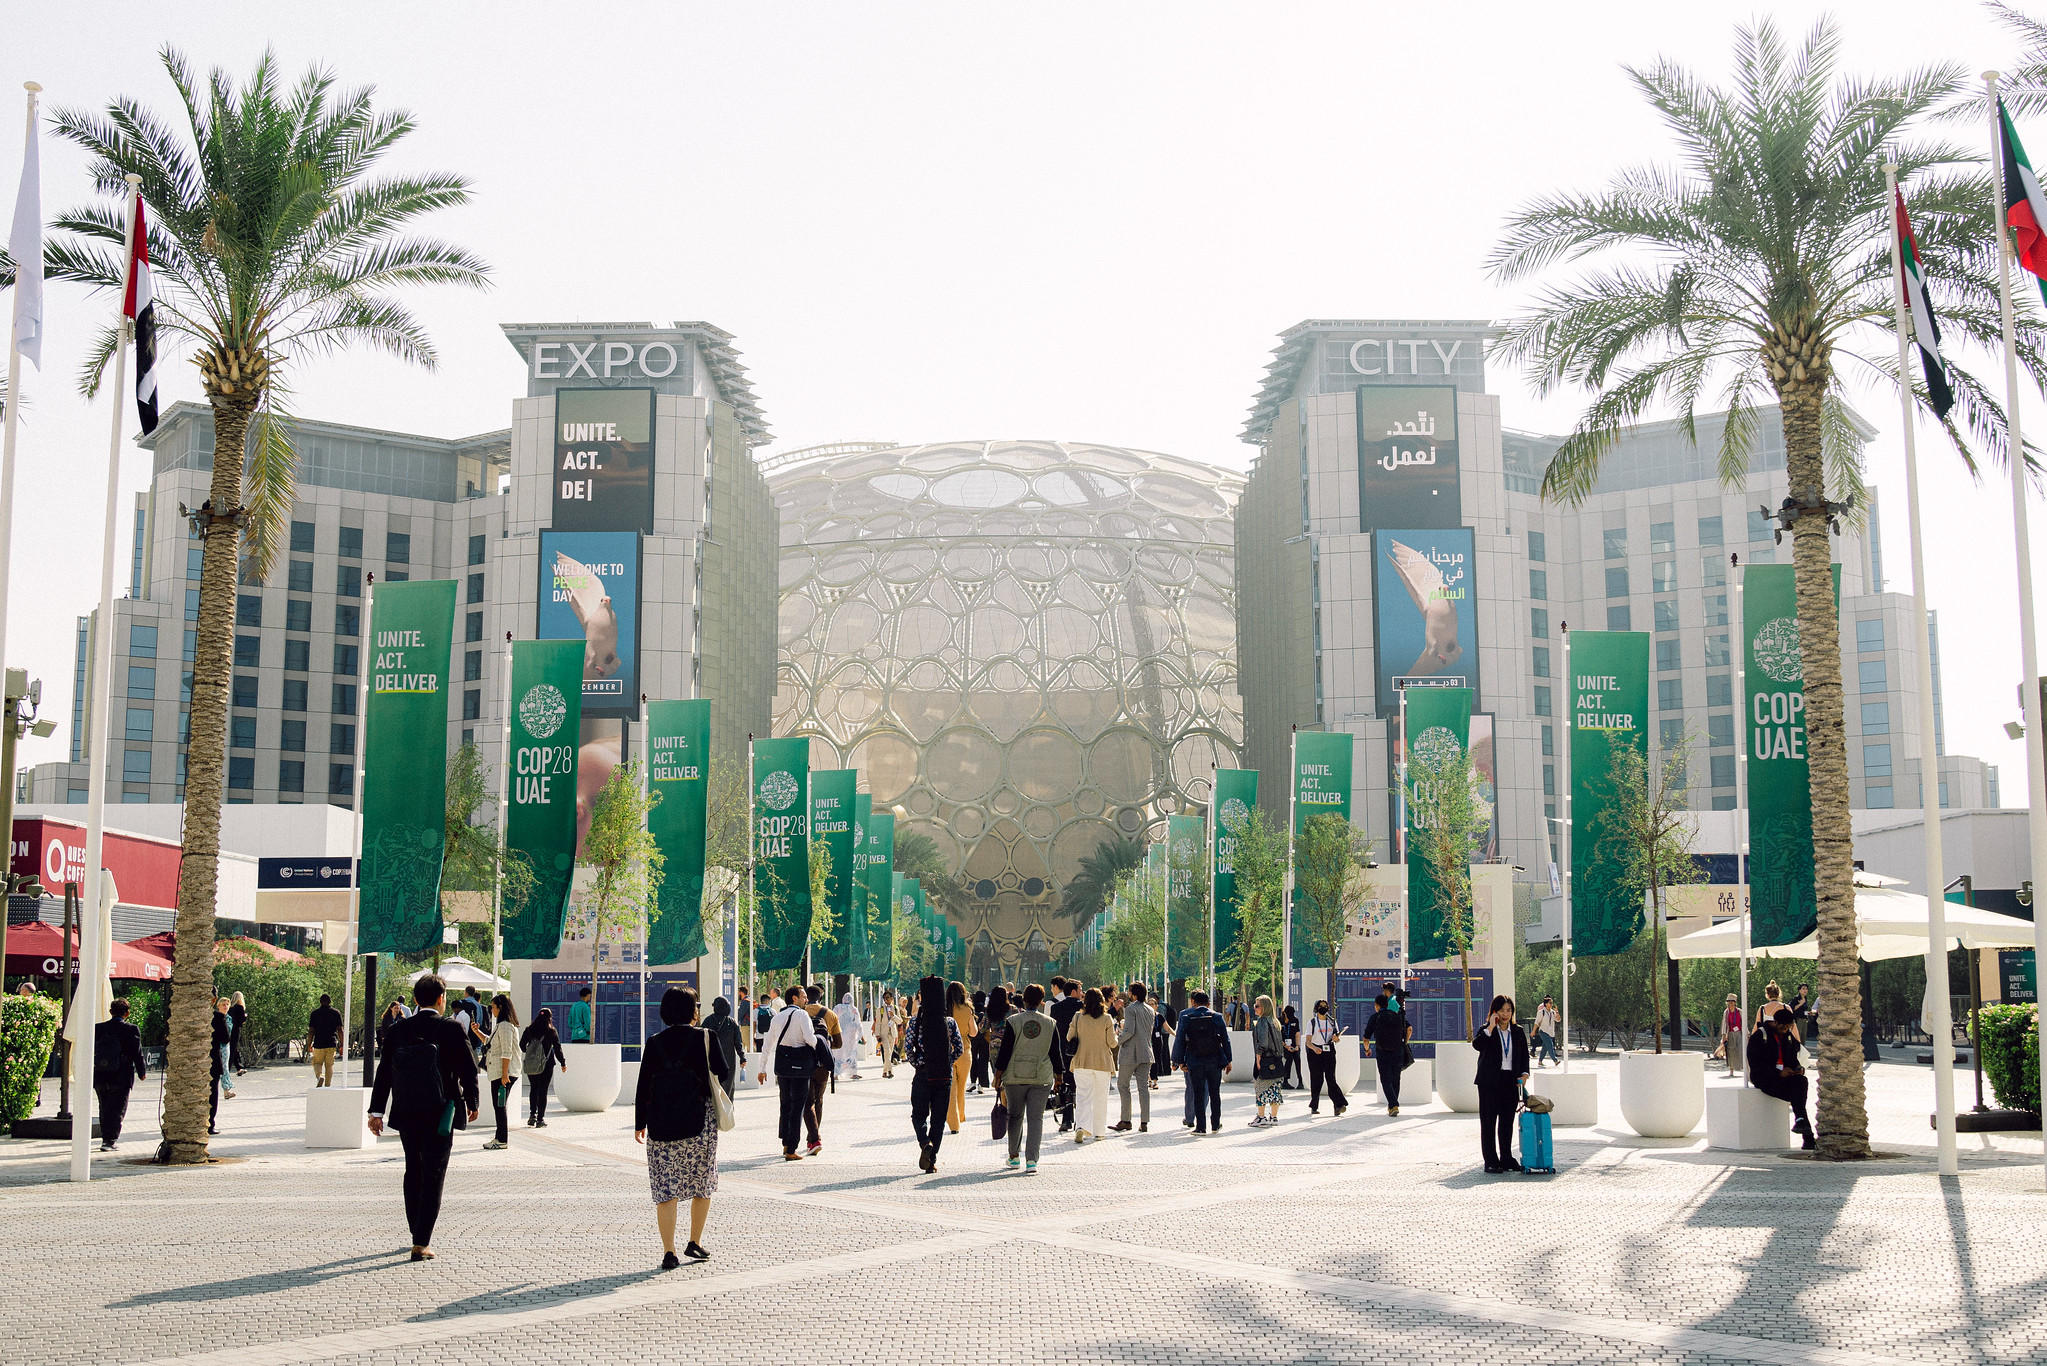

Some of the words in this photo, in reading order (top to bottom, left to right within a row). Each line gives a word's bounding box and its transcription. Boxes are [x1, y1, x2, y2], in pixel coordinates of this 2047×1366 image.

[534, 341, 678, 379] EXPO
[1350, 338, 1463, 375] CITY
[563, 423, 622, 442] UNITE.
[562, 451, 602, 470] ACT.
[553, 563, 608, 576] WELCOME
[610, 563, 624, 576] TO
[1446, 567, 1464, 586] في
[553, 577, 588, 589] PEACE
[552, 590, 574, 603] DAY
[377, 630, 425, 648] UNITE.
[375, 652, 407, 669] ACT.
[375, 673, 439, 691] DELIVER.
[581, 683, 616, 691] CEMBER
[1577, 675, 1621, 691] UNITE.
[1576, 694, 1606, 709] ACT.
[1753, 692, 1804, 725] COP
[1577, 713, 1636, 729] DELIVER.
[653, 736, 688, 749] UNITE.
[1754, 727, 1805, 760] UAE
[516, 745, 572, 775] COP28
[652, 751, 677, 764] ACT.
[653, 766, 701, 780] DELIVER.
[1300, 763, 1332, 776] UNITE.
[515, 776, 551, 805] UAE
[1300, 777, 1321, 789] ACT.
[815, 798, 841, 809] UNITE.
[1301, 791, 1344, 804] DELIVER.
[815, 811, 832, 820] ACT.
[760, 815, 806, 837] COP28
[815, 821, 850, 832] DELIVER.
[67, 846, 86, 864] QUES
[760, 837, 791, 859] UAE
[869, 855, 888, 863] IVER.
[66, 865, 85, 882] COFF
[1171, 868, 1192, 883] COP
[2008, 974, 2028, 982] UNITE.
[2009, 982, 2022, 990] ACT.
